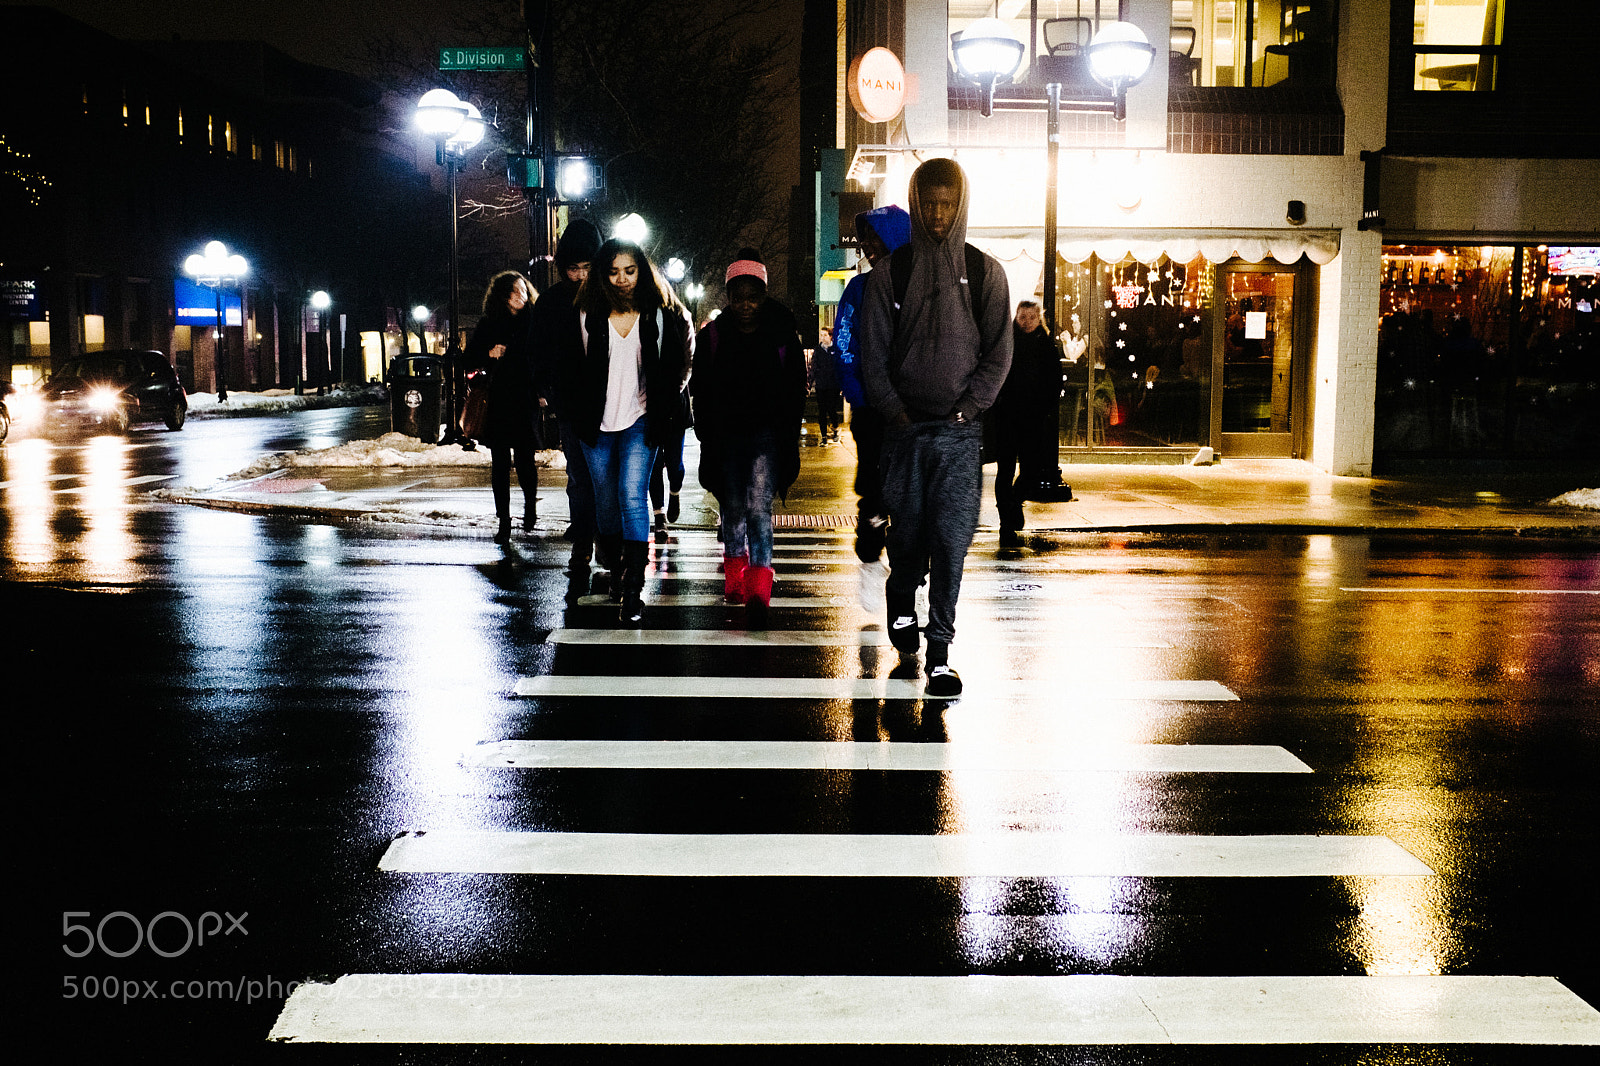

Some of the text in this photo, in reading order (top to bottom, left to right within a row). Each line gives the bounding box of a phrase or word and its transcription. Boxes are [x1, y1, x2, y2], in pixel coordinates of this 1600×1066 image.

[443, 51, 454, 65] S.
[457, 51, 505, 65] Division
[862, 78, 901, 92] MANI
[1364, 210, 1379, 218] MANI
